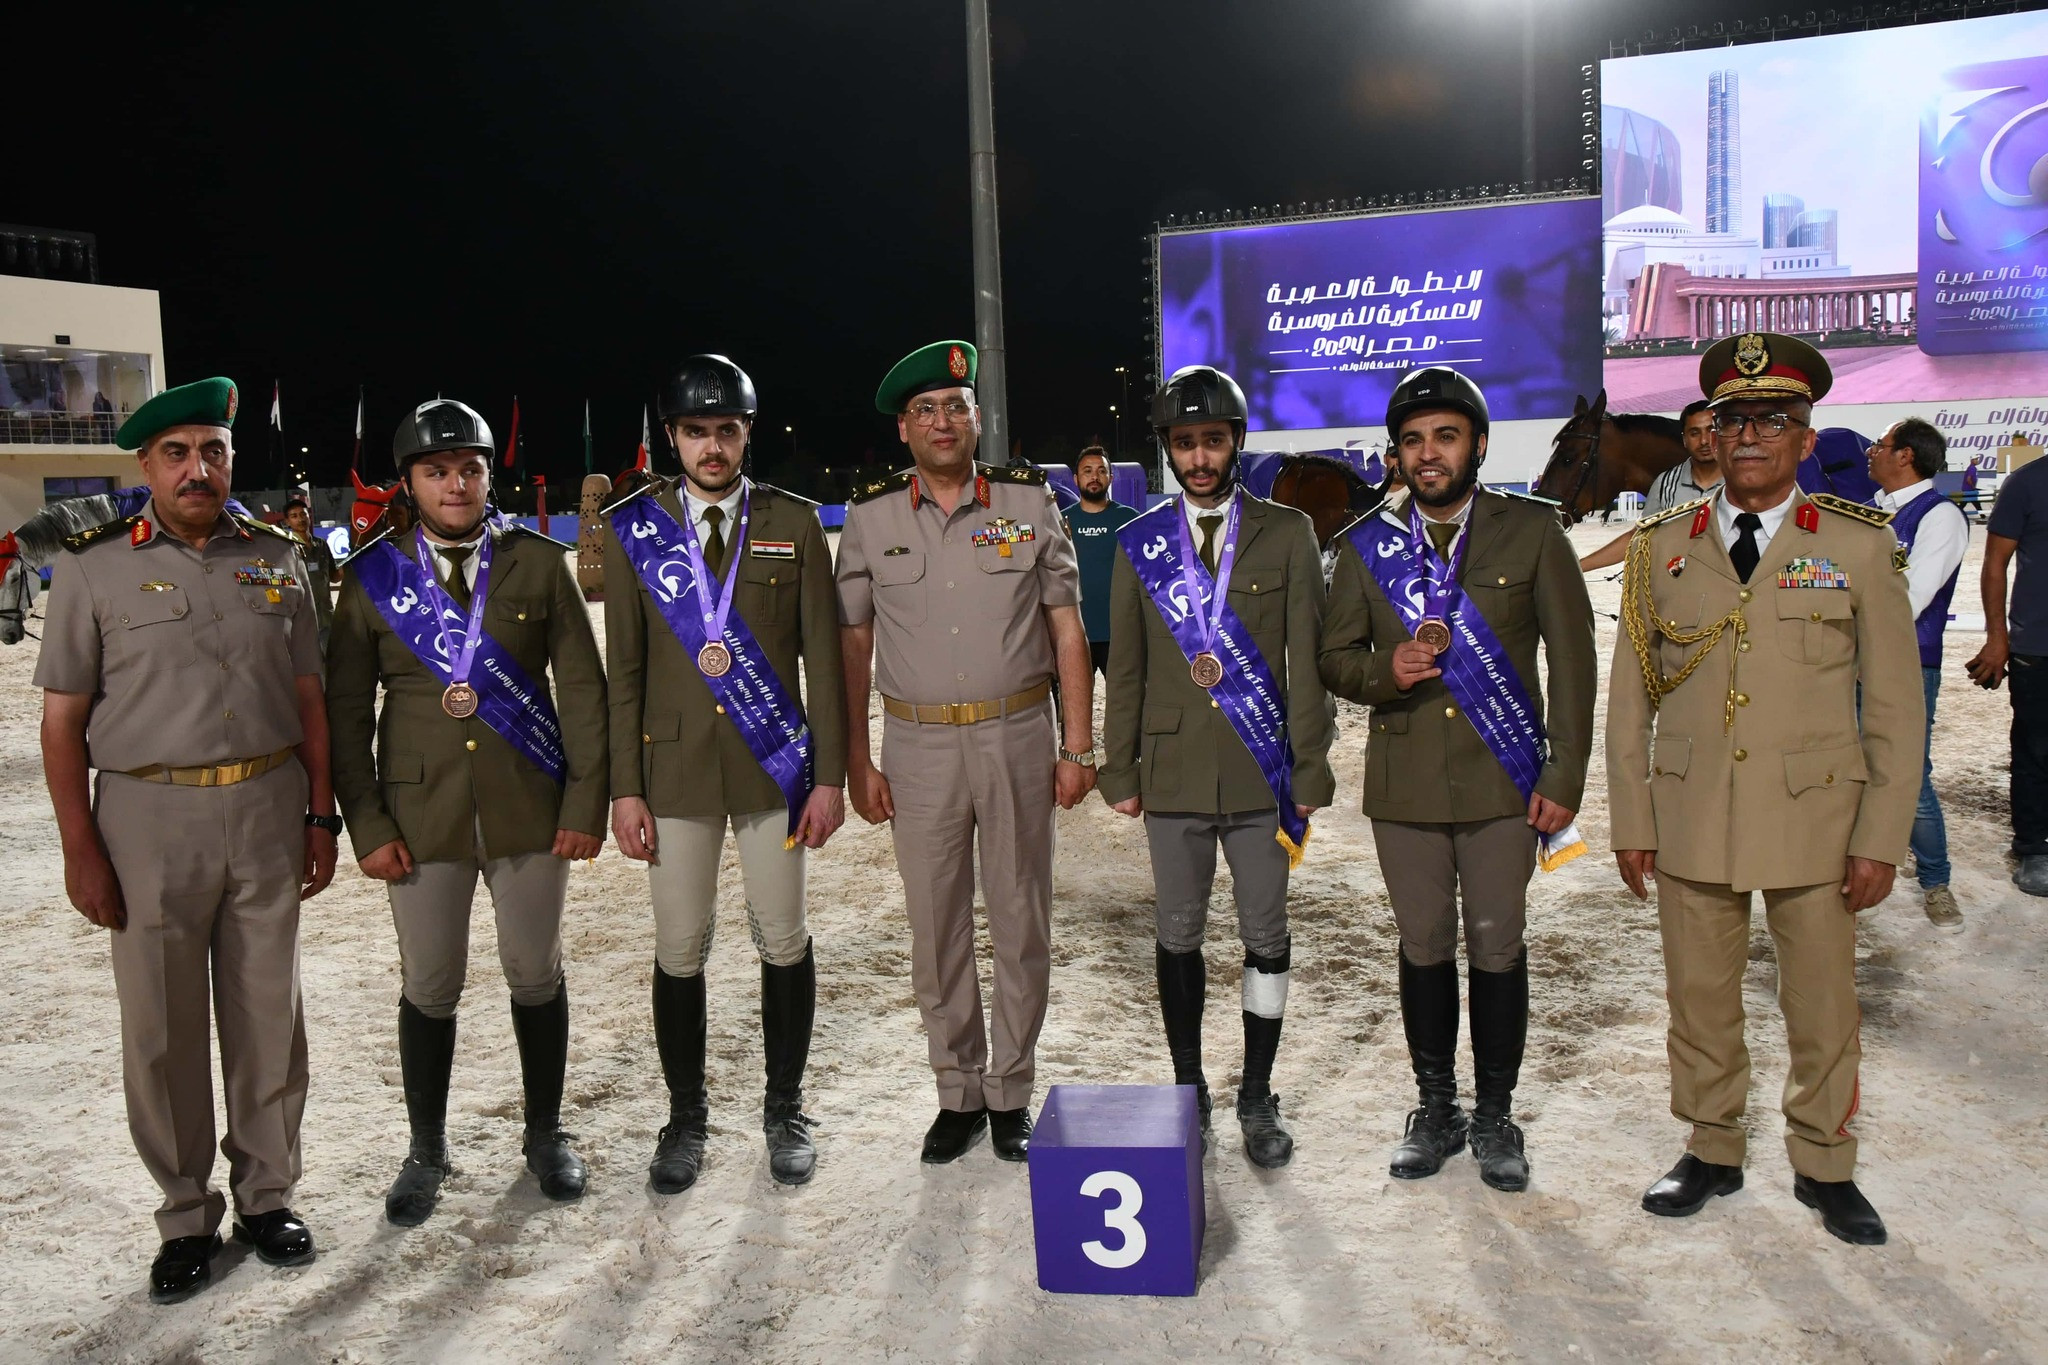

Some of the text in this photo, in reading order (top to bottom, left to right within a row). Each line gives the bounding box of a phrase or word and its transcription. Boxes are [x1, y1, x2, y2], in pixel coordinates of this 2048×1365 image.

[1267, 269, 1483, 305] البطولة العربية
[1935, 266, 2009, 285] العربية
[1267, 299, 1483, 334] العسكرية للفروسية
[1968, 305, 2012, 321] 2024
[1311, 334, 1437, 358] مصر 2024
[1079, 1170, 1147, 1269] 3
